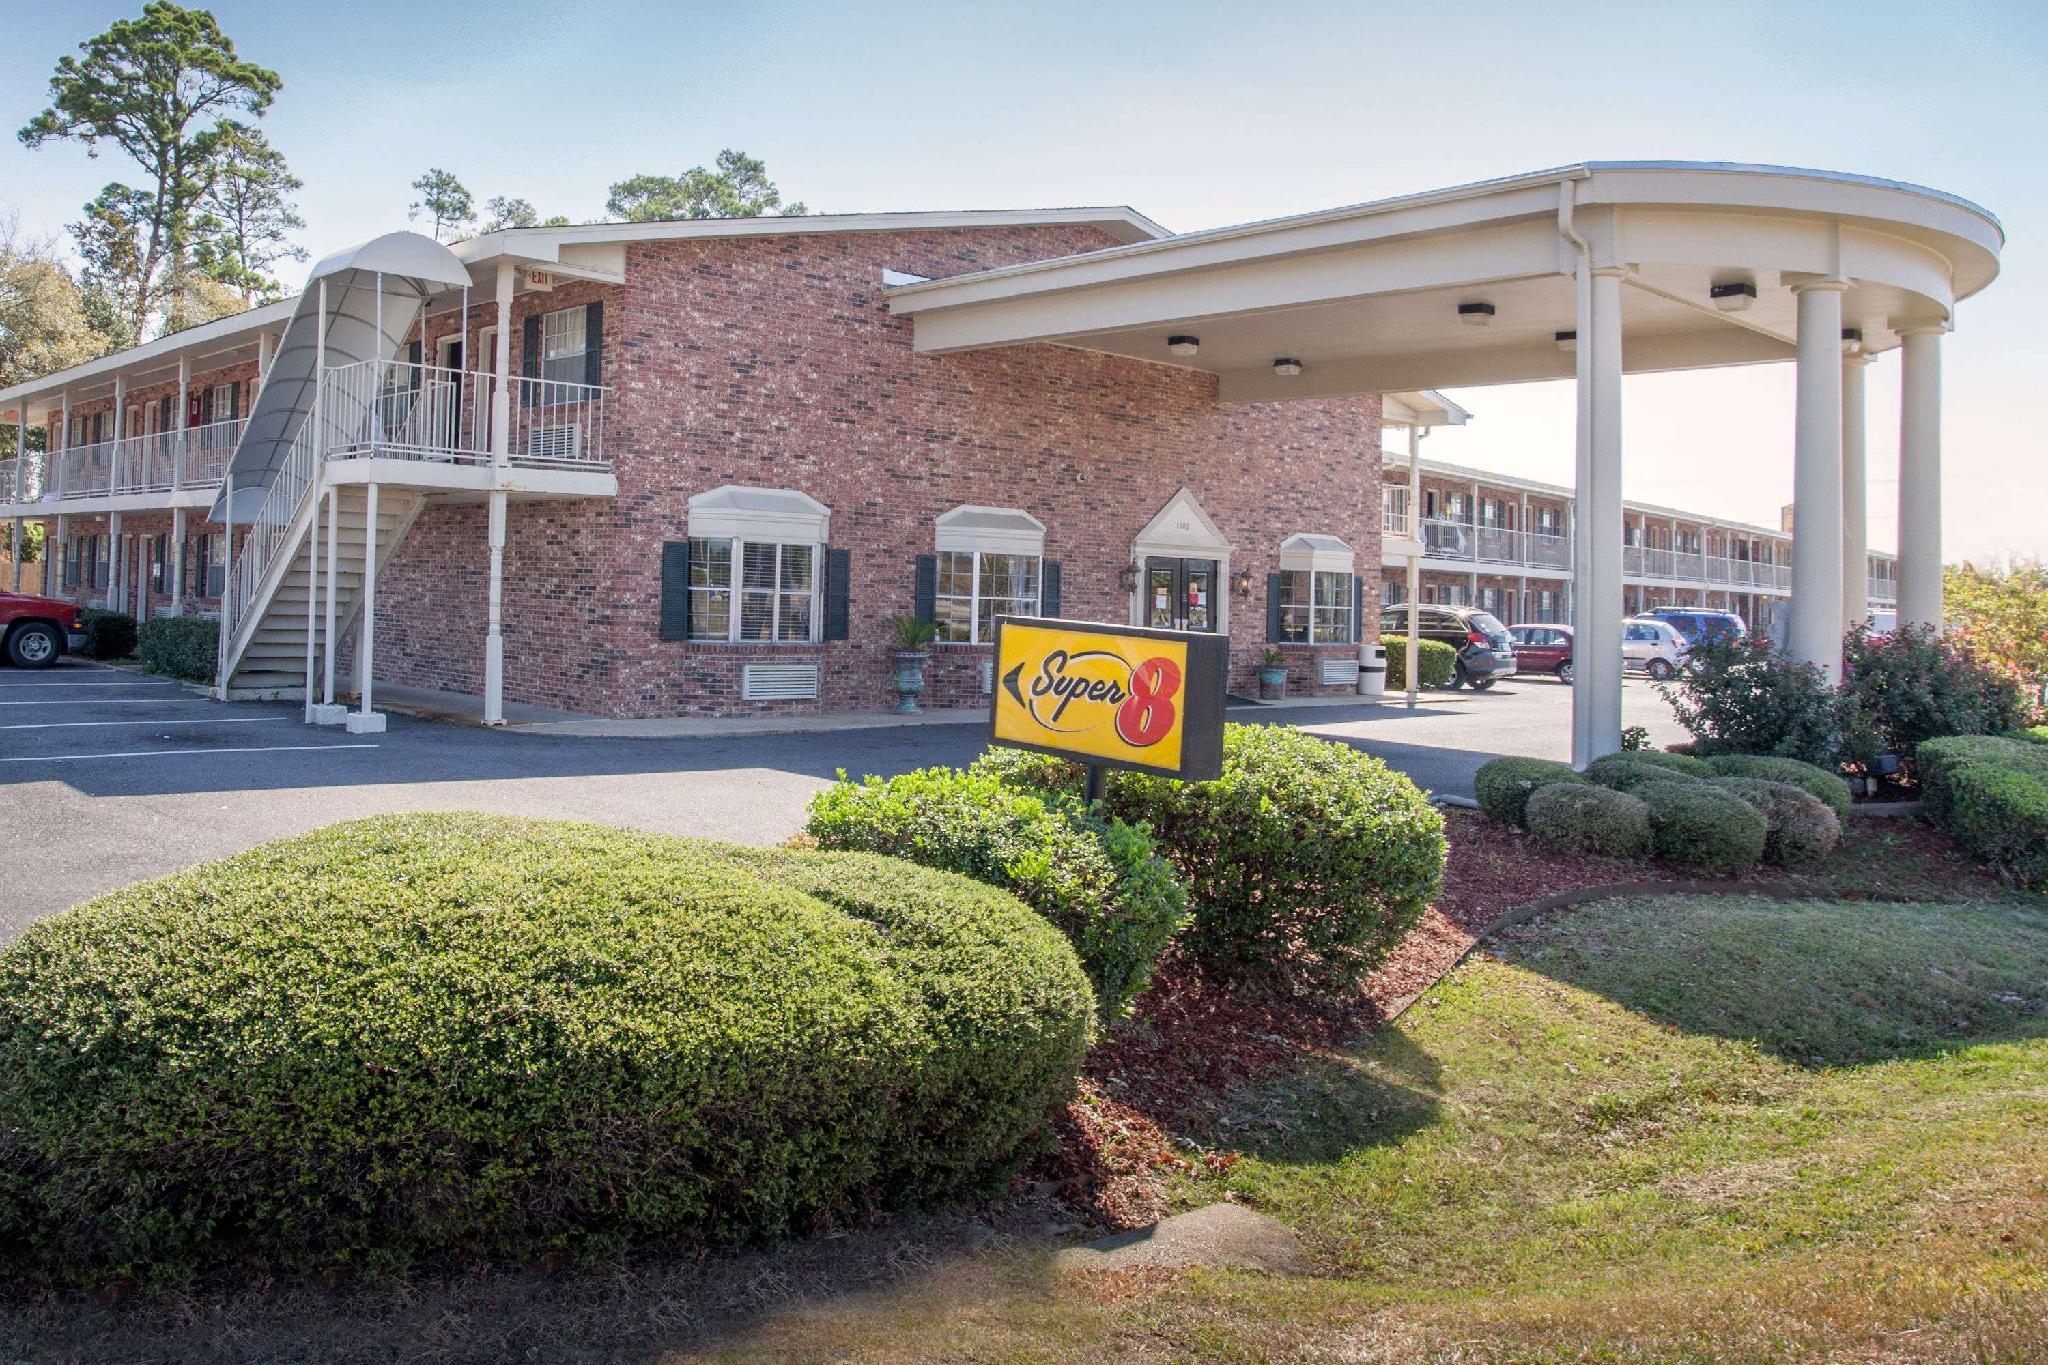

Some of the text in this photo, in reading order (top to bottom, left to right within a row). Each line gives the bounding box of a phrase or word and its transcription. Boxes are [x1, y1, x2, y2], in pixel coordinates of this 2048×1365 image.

[531, 270, 548, 285] EXIT
[1031, 649, 1181, 747] Super 8
